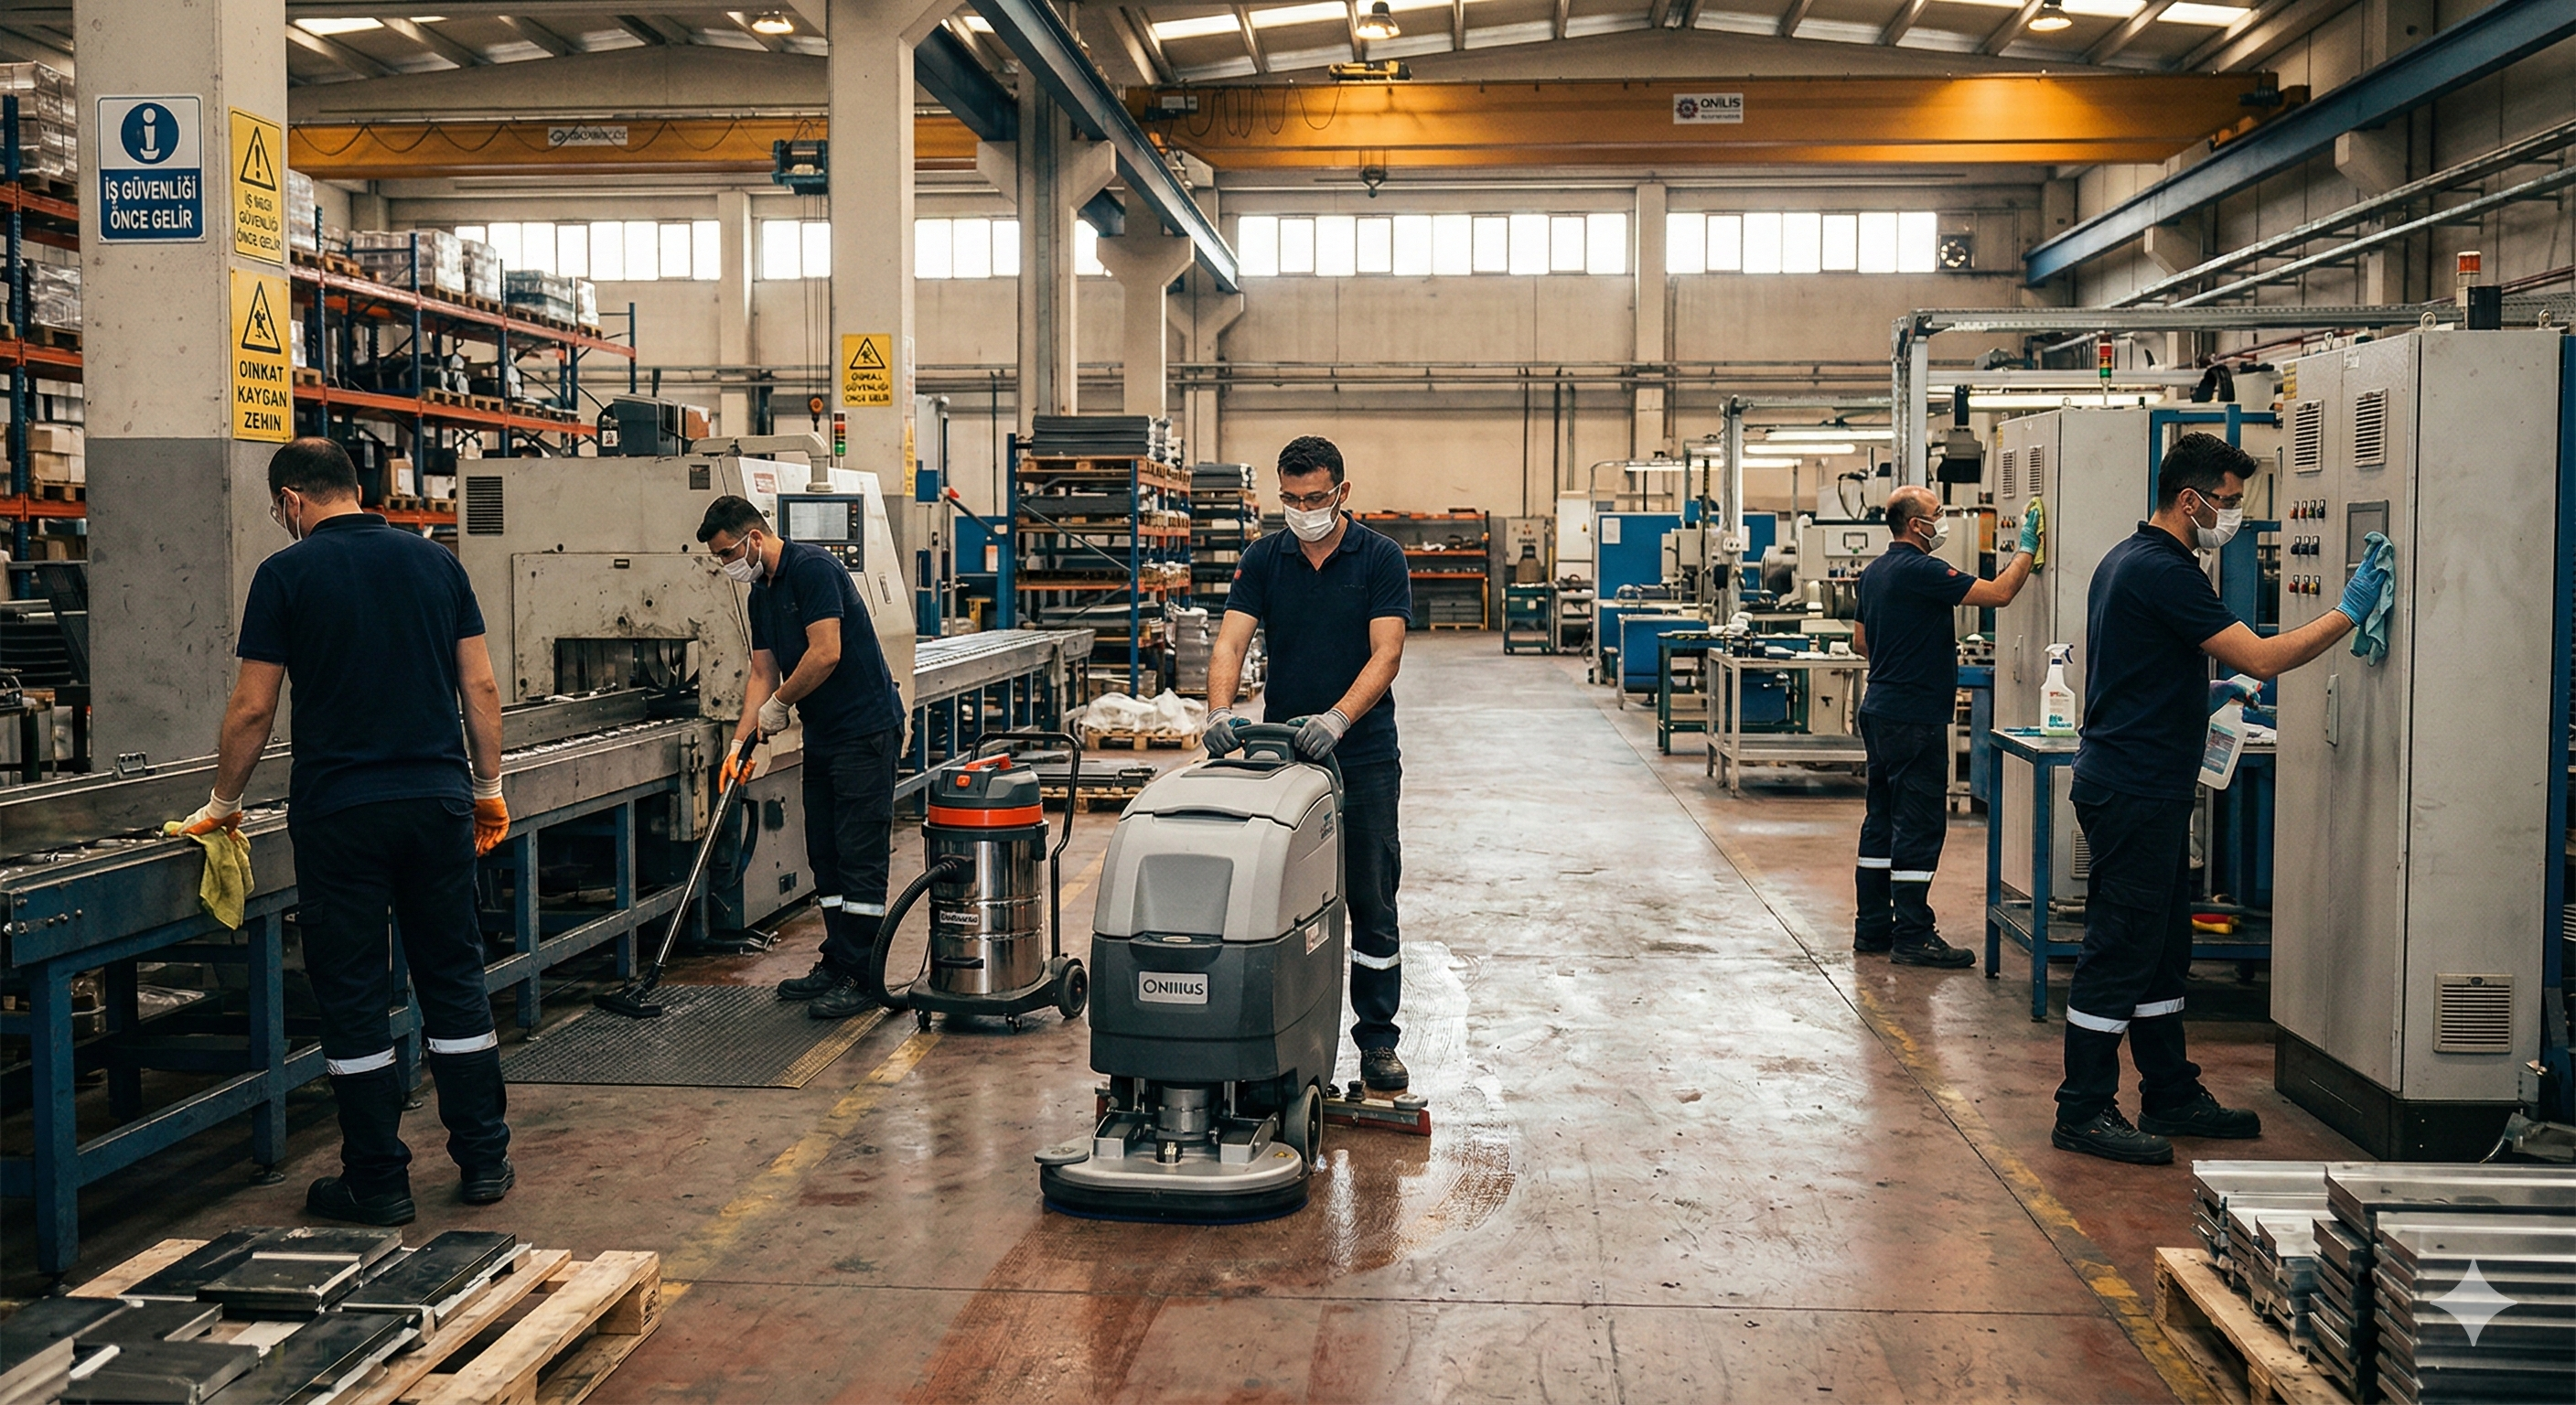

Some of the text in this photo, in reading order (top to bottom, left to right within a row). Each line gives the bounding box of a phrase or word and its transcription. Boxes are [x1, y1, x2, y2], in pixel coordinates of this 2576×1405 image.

[105, 175, 197, 205] İŞ GÜVENLİĞİ
[110, 203, 194, 230] ÖNCE GELİR
[239, 359, 284, 382] OINKAT
[238, 385, 287, 408] KAYGAN
